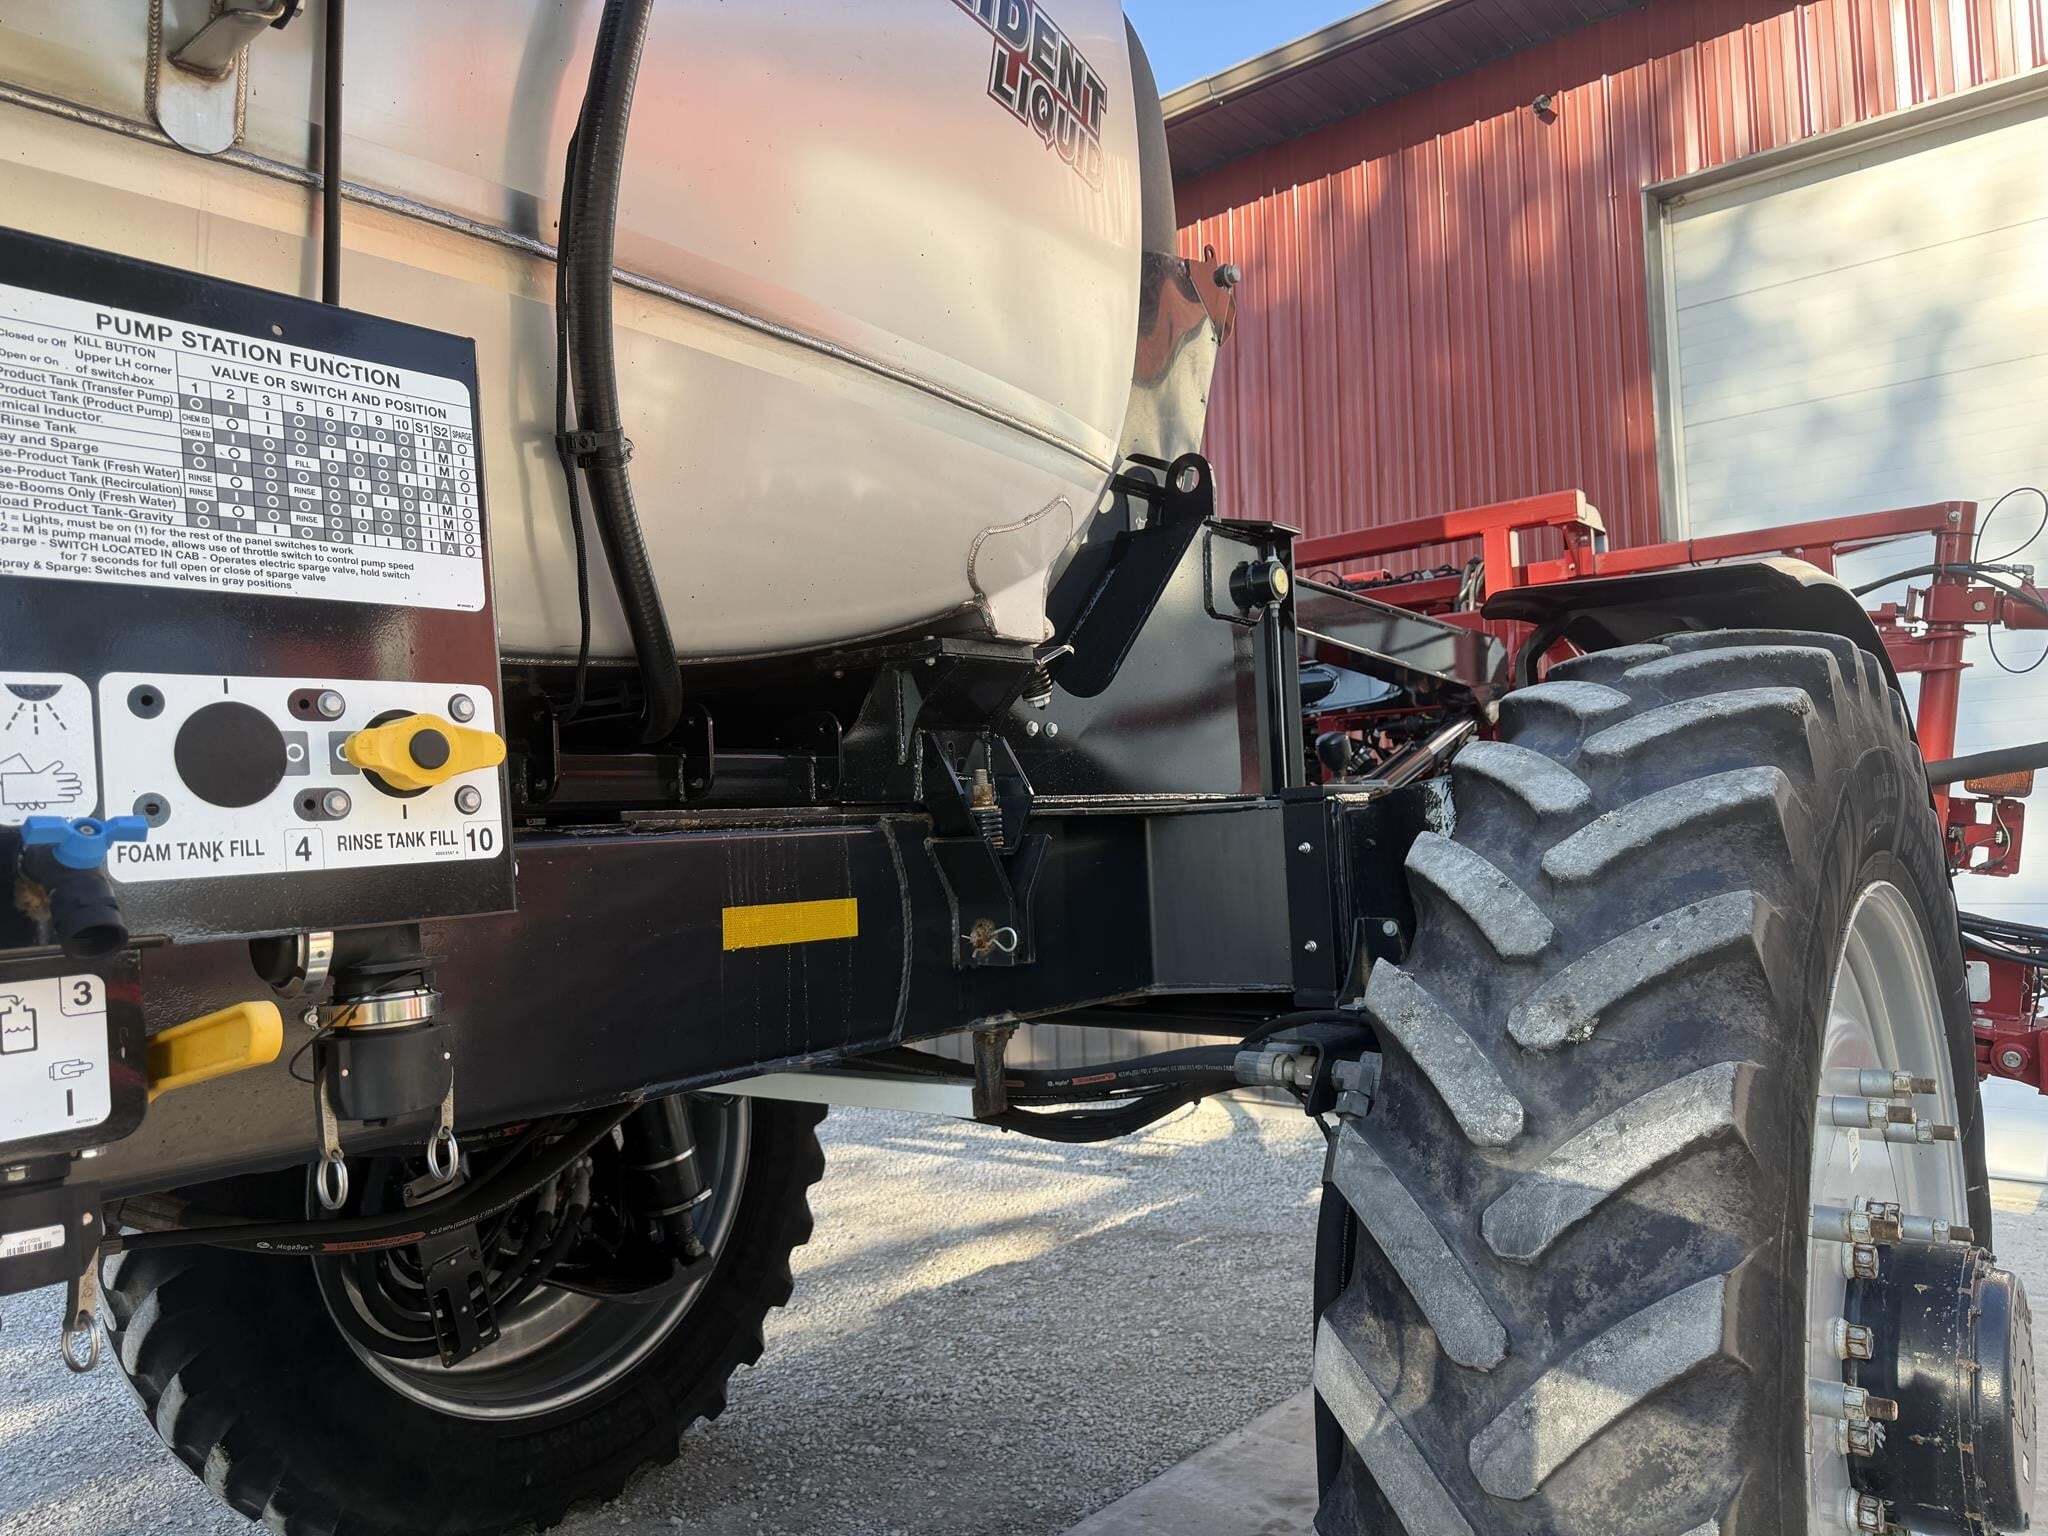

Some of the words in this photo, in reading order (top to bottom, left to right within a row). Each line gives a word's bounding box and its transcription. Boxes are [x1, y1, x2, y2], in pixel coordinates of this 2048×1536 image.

[987, 42, 1104, 192] LIQUID
[38, 336, 48, 344] or
[52, 338, 67, 348] Off
[74, 335, 102, 348] KILL
[106, 341, 156, 358] BUTTON
[96, 313, 172, 342] PUMP
[182, 331, 282, 365] STATION
[290, 352, 400, 388] FUNCTION
[30, 354, 41, 362] or
[44, 356, 58, 366] On
[75, 350, 112, 364] Upper
[116, 357, 130, 368] LH
[135, 362, 172, 375] corner
[76, 365, 87, 374] of
[91, 368, 130, 382] switch
[134, 374, 154, 385] box
[50, 375, 82, 389] Tank
[82, 380, 134, 398] (Transfer
[138, 388, 174, 405] Pump)
[212, 365, 259, 384] VALVE
[264, 376, 286, 389] OR
[291, 380, 347, 400] SWITCH
[352, 392, 380, 406] AND
[386, 398, 446, 419] POSITION
[0, 400, 39, 414] mical
[51, 391, 80, 404] Tank
[83, 397, 134, 414] (Product
[137, 406, 173, 421] Pump)
[192, 382, 198, 394] 1
[226, 389, 234, 400] 2
[262, 395, 270, 406] 3
[296, 402, 304, 412] 5
[326, 406, 334, 417] 6
[350, 411, 358, 421] 7
[375, 416, 382, 426] 9
[396, 420, 409, 430] 10
[415, 423, 429, 434] S1
[434, 426, 448, 438] S2
[452, 430, 472, 441] SPARGE
[1, 414, 40, 428] Rinse
[45, 420, 76, 434] Tank
[0, 433, 16, 444] ay
[20, 434, 46, 446] and
[50, 438, 98, 453] Sparge
[0, 448, 68, 464] se-Product
[72, 455, 100, 468] Tank
[104, 461, 140, 474] (Fresh
[144, 465, 181, 480] Water)
[296, 460, 310, 468] FILL
[0, 466, 66, 480] se-Product
[70, 471, 98, 484] Tank
[102, 475, 183, 496] (Recirculation)
[188, 474, 212, 483] RINSE
[294, 486, 316, 496] RINSE
[0, 480, 64, 496] se-Booms
[68, 487, 96, 500] Only
[100, 490, 136, 504] (Fresh
[140, 494, 176, 510] Water)
[190, 488, 214, 497] RINSE
[34, 498, 88, 514] Product
[92, 504, 174, 526] Tank-Gravity
[296, 514, 318, 524] RINSE
[22, 513, 63, 526] Lights,
[67, 520, 96, 530] must
[100, 521, 113, 530] be
[117, 524, 130, 532] on
[134, 524, 148, 535] (1)
[151, 527, 166, 536] for
[170, 528, 186, 538] the
[190, 532, 210, 541] rest
[213, 533, 224, 542] of
[226, 534, 242, 544] the
[245, 537, 272, 548] panel
[275, 541, 316, 552] switches
[319, 544, 328, 552] to
[332, 546, 354, 556] work
[0, 536, 36, 548] parge
[50, 539, 98, 551] SWITCH
[102, 544, 157, 556] LOCATED
[161, 548, 172, 558] IN
[176, 551, 199, 560] CAB
[210, 554, 256, 566] Operates
[260, 560, 295, 570] electric
[298, 563, 330, 574] sparge
[333, 566, 359, 576] valve,
[361, 568, 379, 577] hold
[382, 571, 410, 580] switch
[24, 526, 34, 534] M
[38, 526, 48, 536] is
[52, 530, 85, 541] pump
[90, 532, 130, 544] manual
[134, 536, 168, 548] mode,
[172, 540, 206, 550] allows
[230, 545, 240, 554] of
[243, 547, 278, 558] throttle
[282, 550, 312, 561] switch
[327, 556, 358, 565] control
[361, 560, 386, 569] pump
[389, 561, 414, 571] speed
[34, 560, 42, 570] &
[46, 562, 91, 574] Sparge:
[96, 566, 146, 578] Switches
[150, 571, 170, 580] and
[174, 574, 207, 583] valves
[210, 576, 219, 584] in
[222, 578, 244, 587] gray
[248, 580, 292, 590] positions
[60, 551, 76, 561] for
[81, 553, 88, 562] 7
[92, 554, 139, 567] seconds
[143, 558, 158, 568] for
[161, 560, 177, 569] full
[181, 563, 206, 573] open
[210, 565, 220, 573] or
[224, 566, 250, 576] close
[254, 568, 264, 576] of
[266, 570, 299, 580] sparge
[302, 573, 326, 582] valve
[117, 844, 170, 863] FOAM
[177, 841, 224, 860] TANK
[230, 839, 264, 857] FILL
[295, 836, 312, 862] 4
[338, 833, 383, 851] RINSE
[387, 832, 426, 849] TANK
[430, 830, 458, 846] FILL
[466, 828, 493, 852] 10
[73, 981, 92, 1006] 3
